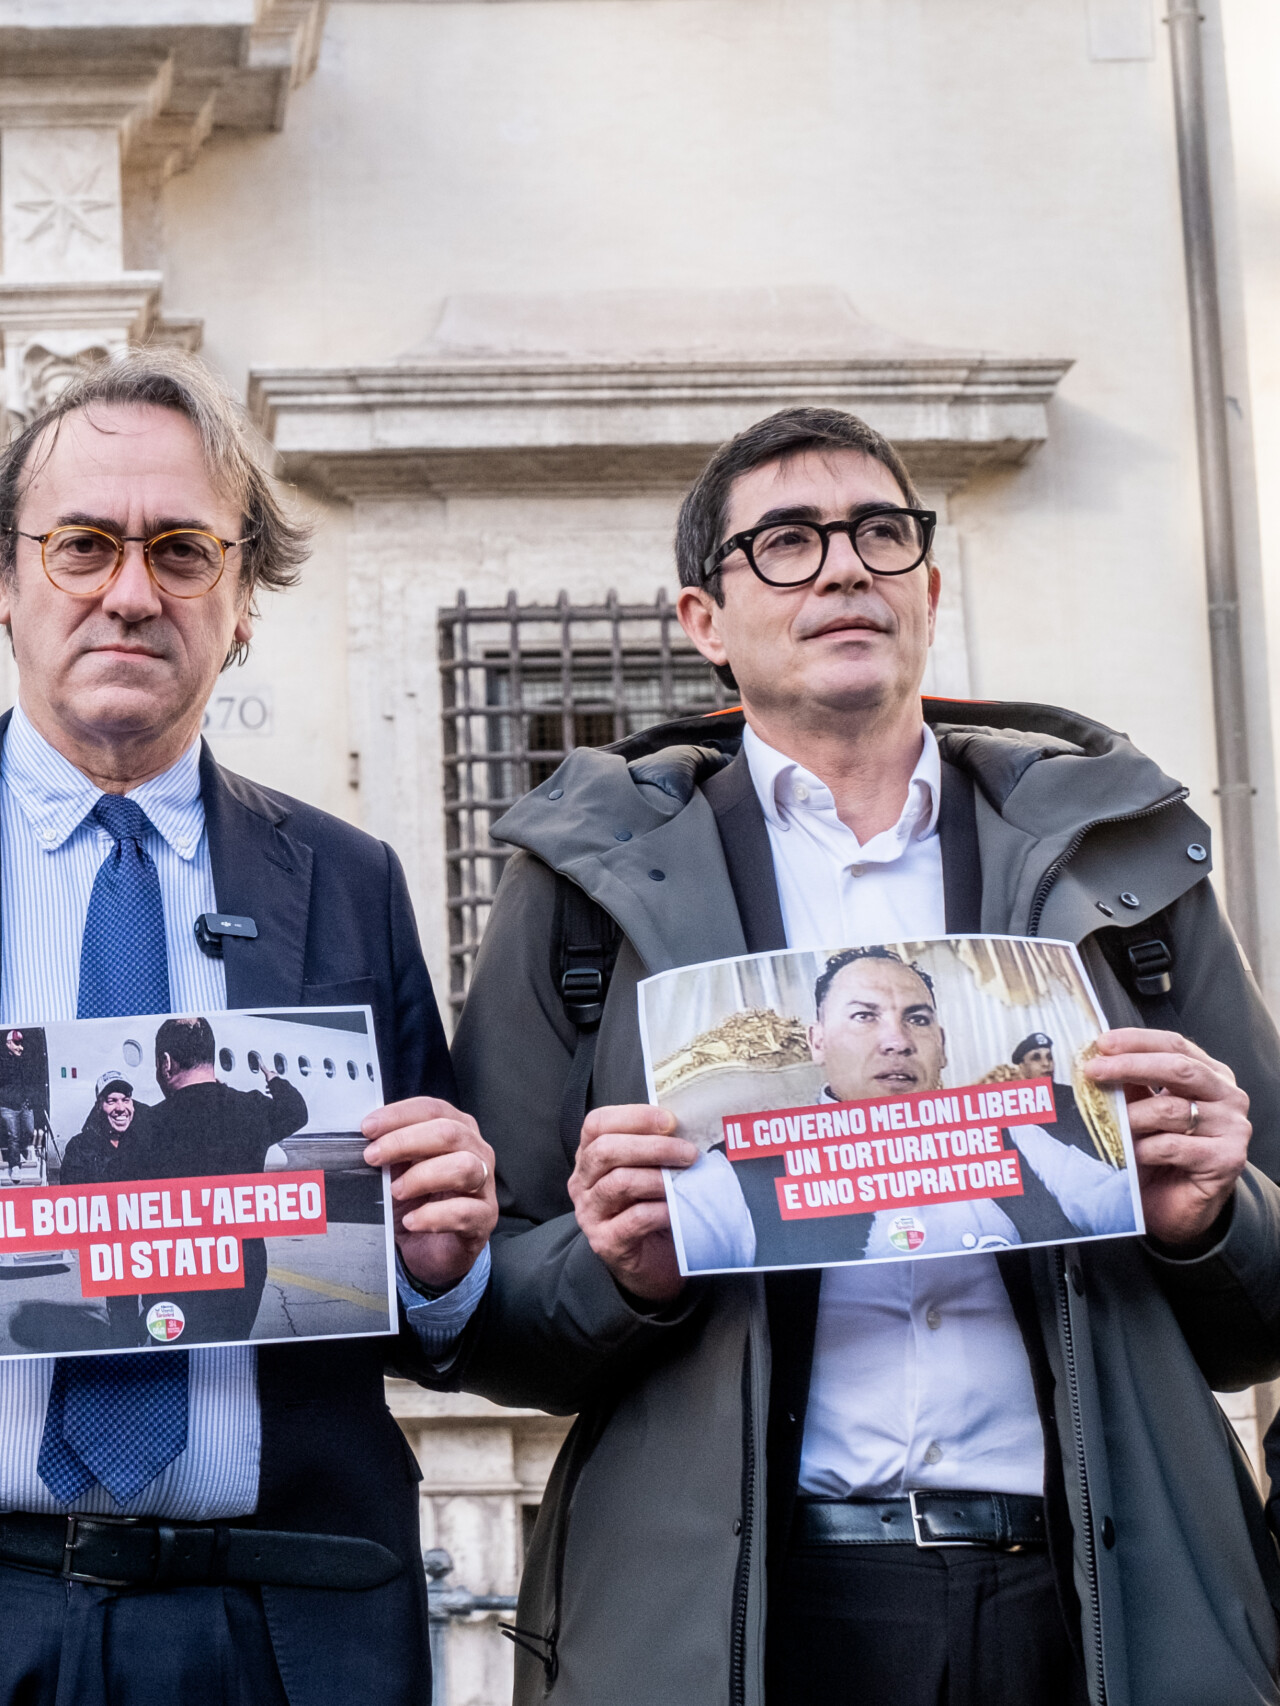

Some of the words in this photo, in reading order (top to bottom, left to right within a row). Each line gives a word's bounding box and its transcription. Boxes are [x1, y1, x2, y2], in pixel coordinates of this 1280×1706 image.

[726, 1123, 750, 1149] IL
[753, 1108, 866, 1146] GOVERNO
[870, 1096, 961, 1132] MELONI
[964, 1086, 1052, 1121] LIBERA
[786, 1148, 821, 1176] UN
[823, 1126, 1001, 1171] TORTURATORE
[784, 1184, 802, 1209] E
[803, 1178, 855, 1207] UNO
[857, 1158, 1019, 1201] STUPRATORE
[32, 1195, 111, 1236] BOIA
[117, 1183, 321, 1230] NELL'AEREO
[90, 1243, 124, 1281] DI
[130, 1236, 239, 1278] STATO
